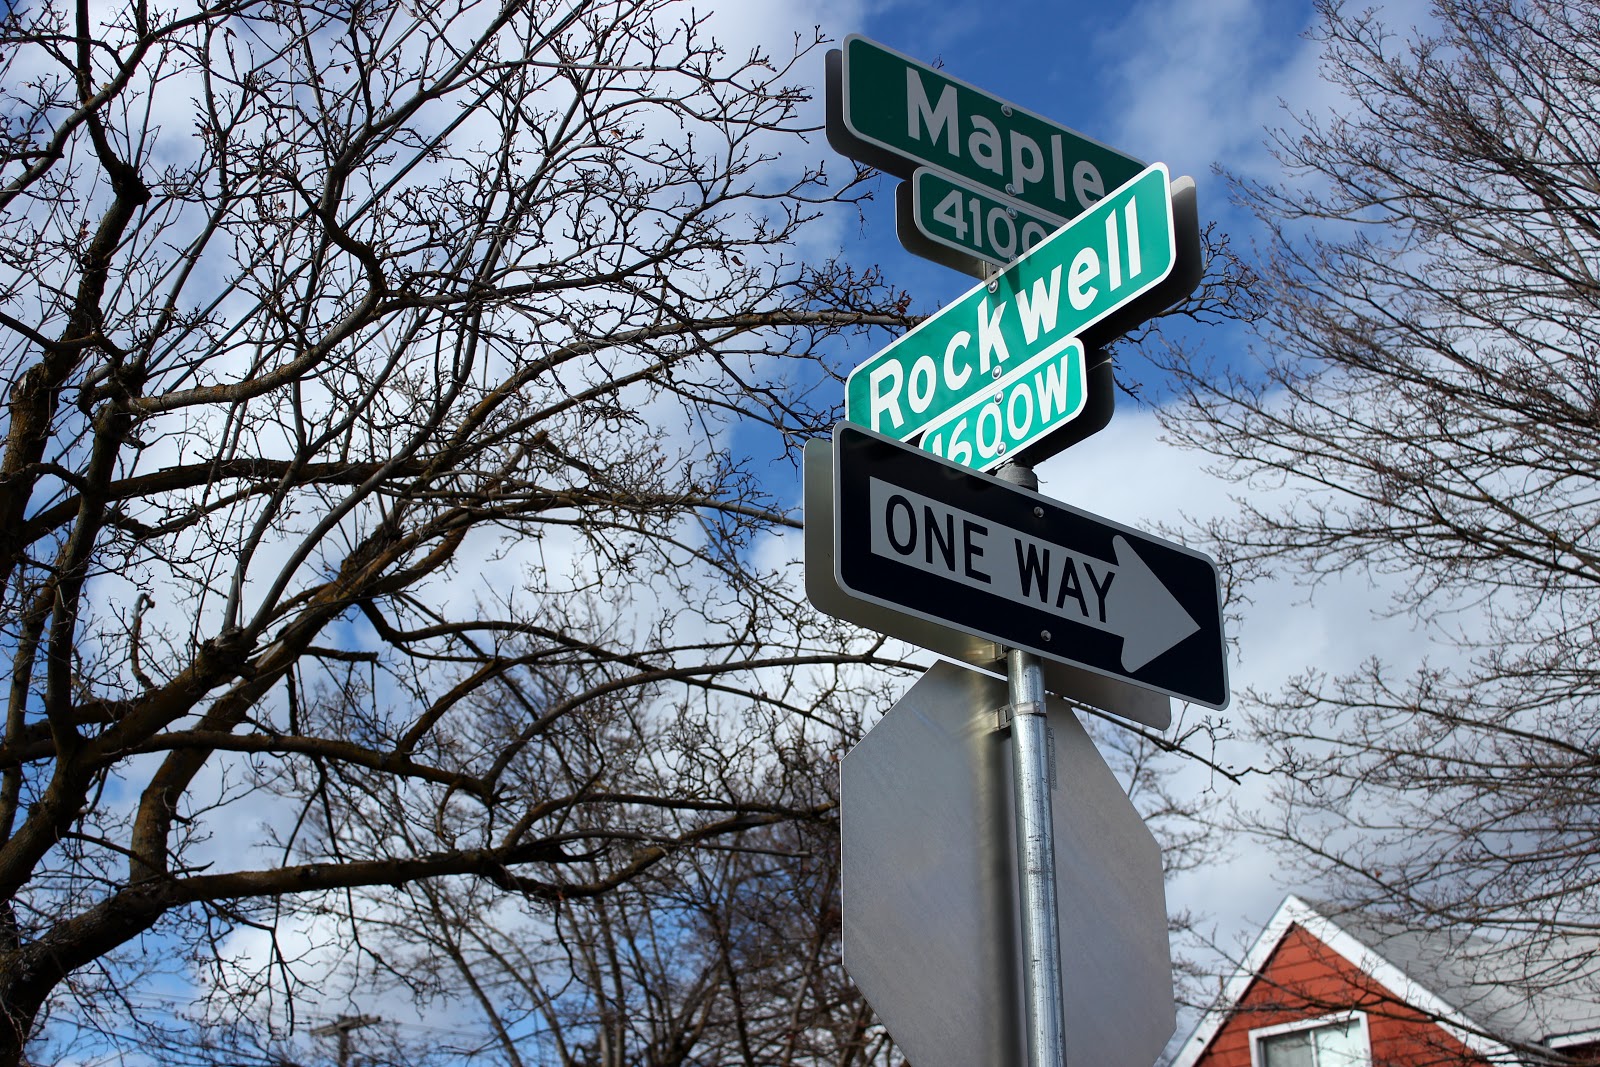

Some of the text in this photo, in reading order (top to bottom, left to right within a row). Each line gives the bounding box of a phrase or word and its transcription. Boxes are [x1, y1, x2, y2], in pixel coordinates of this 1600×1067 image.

[906, 66, 1105, 210] Maple
[869, 194, 1142, 433] Rockwell
[885, 494, 1116, 624] ONE WAY
